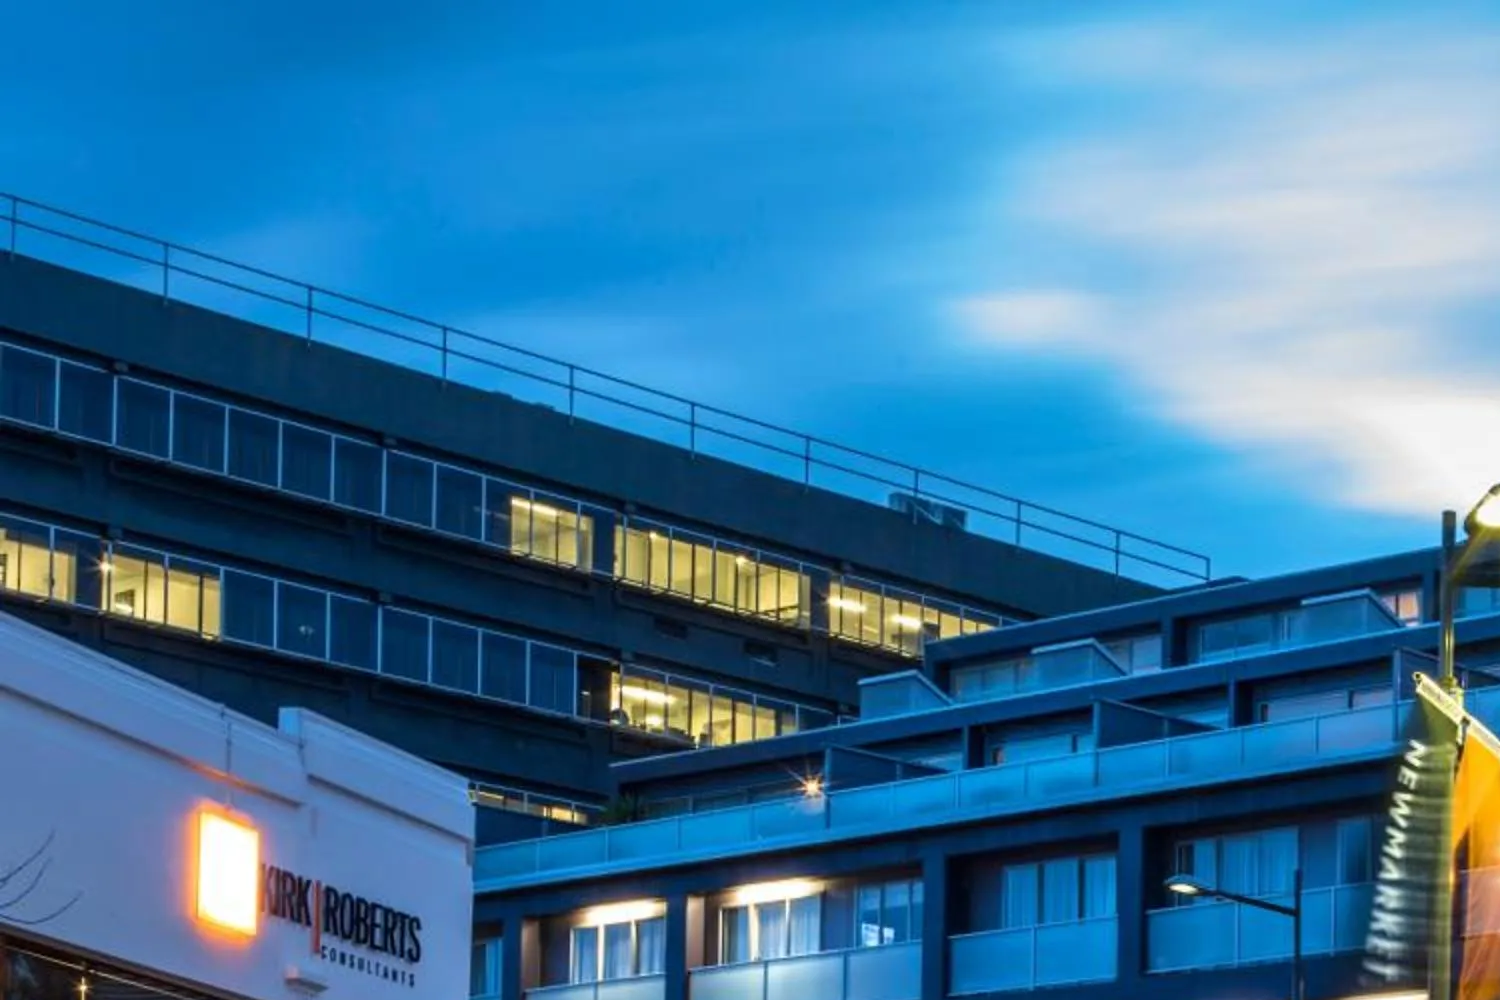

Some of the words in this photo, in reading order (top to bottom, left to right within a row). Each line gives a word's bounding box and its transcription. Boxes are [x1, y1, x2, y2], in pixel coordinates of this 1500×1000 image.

[1362, 739, 1428, 979] NEWMARKET
[260, 863, 312, 927] KIRK
[323, 884, 422, 963] ROBERTS
[321, 945, 415, 988] CONSULTANTS
